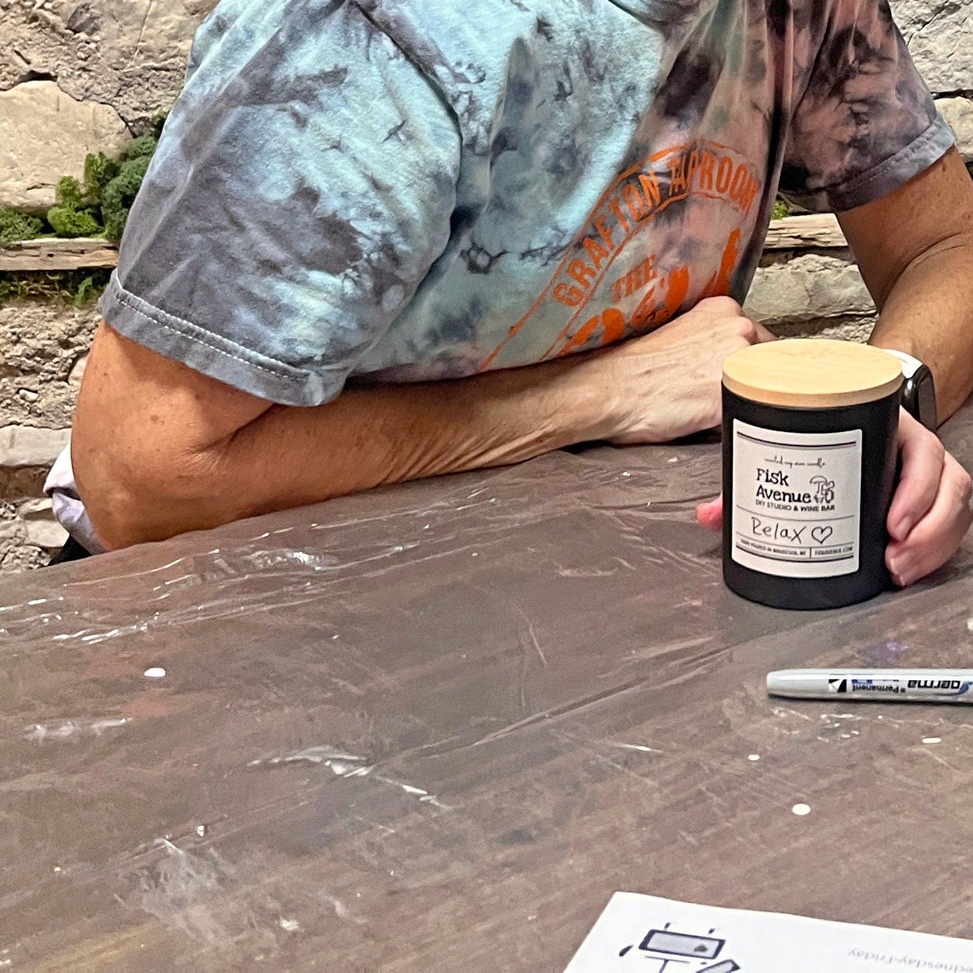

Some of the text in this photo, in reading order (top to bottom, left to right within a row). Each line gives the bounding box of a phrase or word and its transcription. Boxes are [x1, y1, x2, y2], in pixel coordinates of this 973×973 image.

[552, 168, 662, 308] GRAFTON
[756, 467, 789, 487] Fisk
[756, 484, 812, 504] Avenue
[751, 517, 807, 543] Relax
